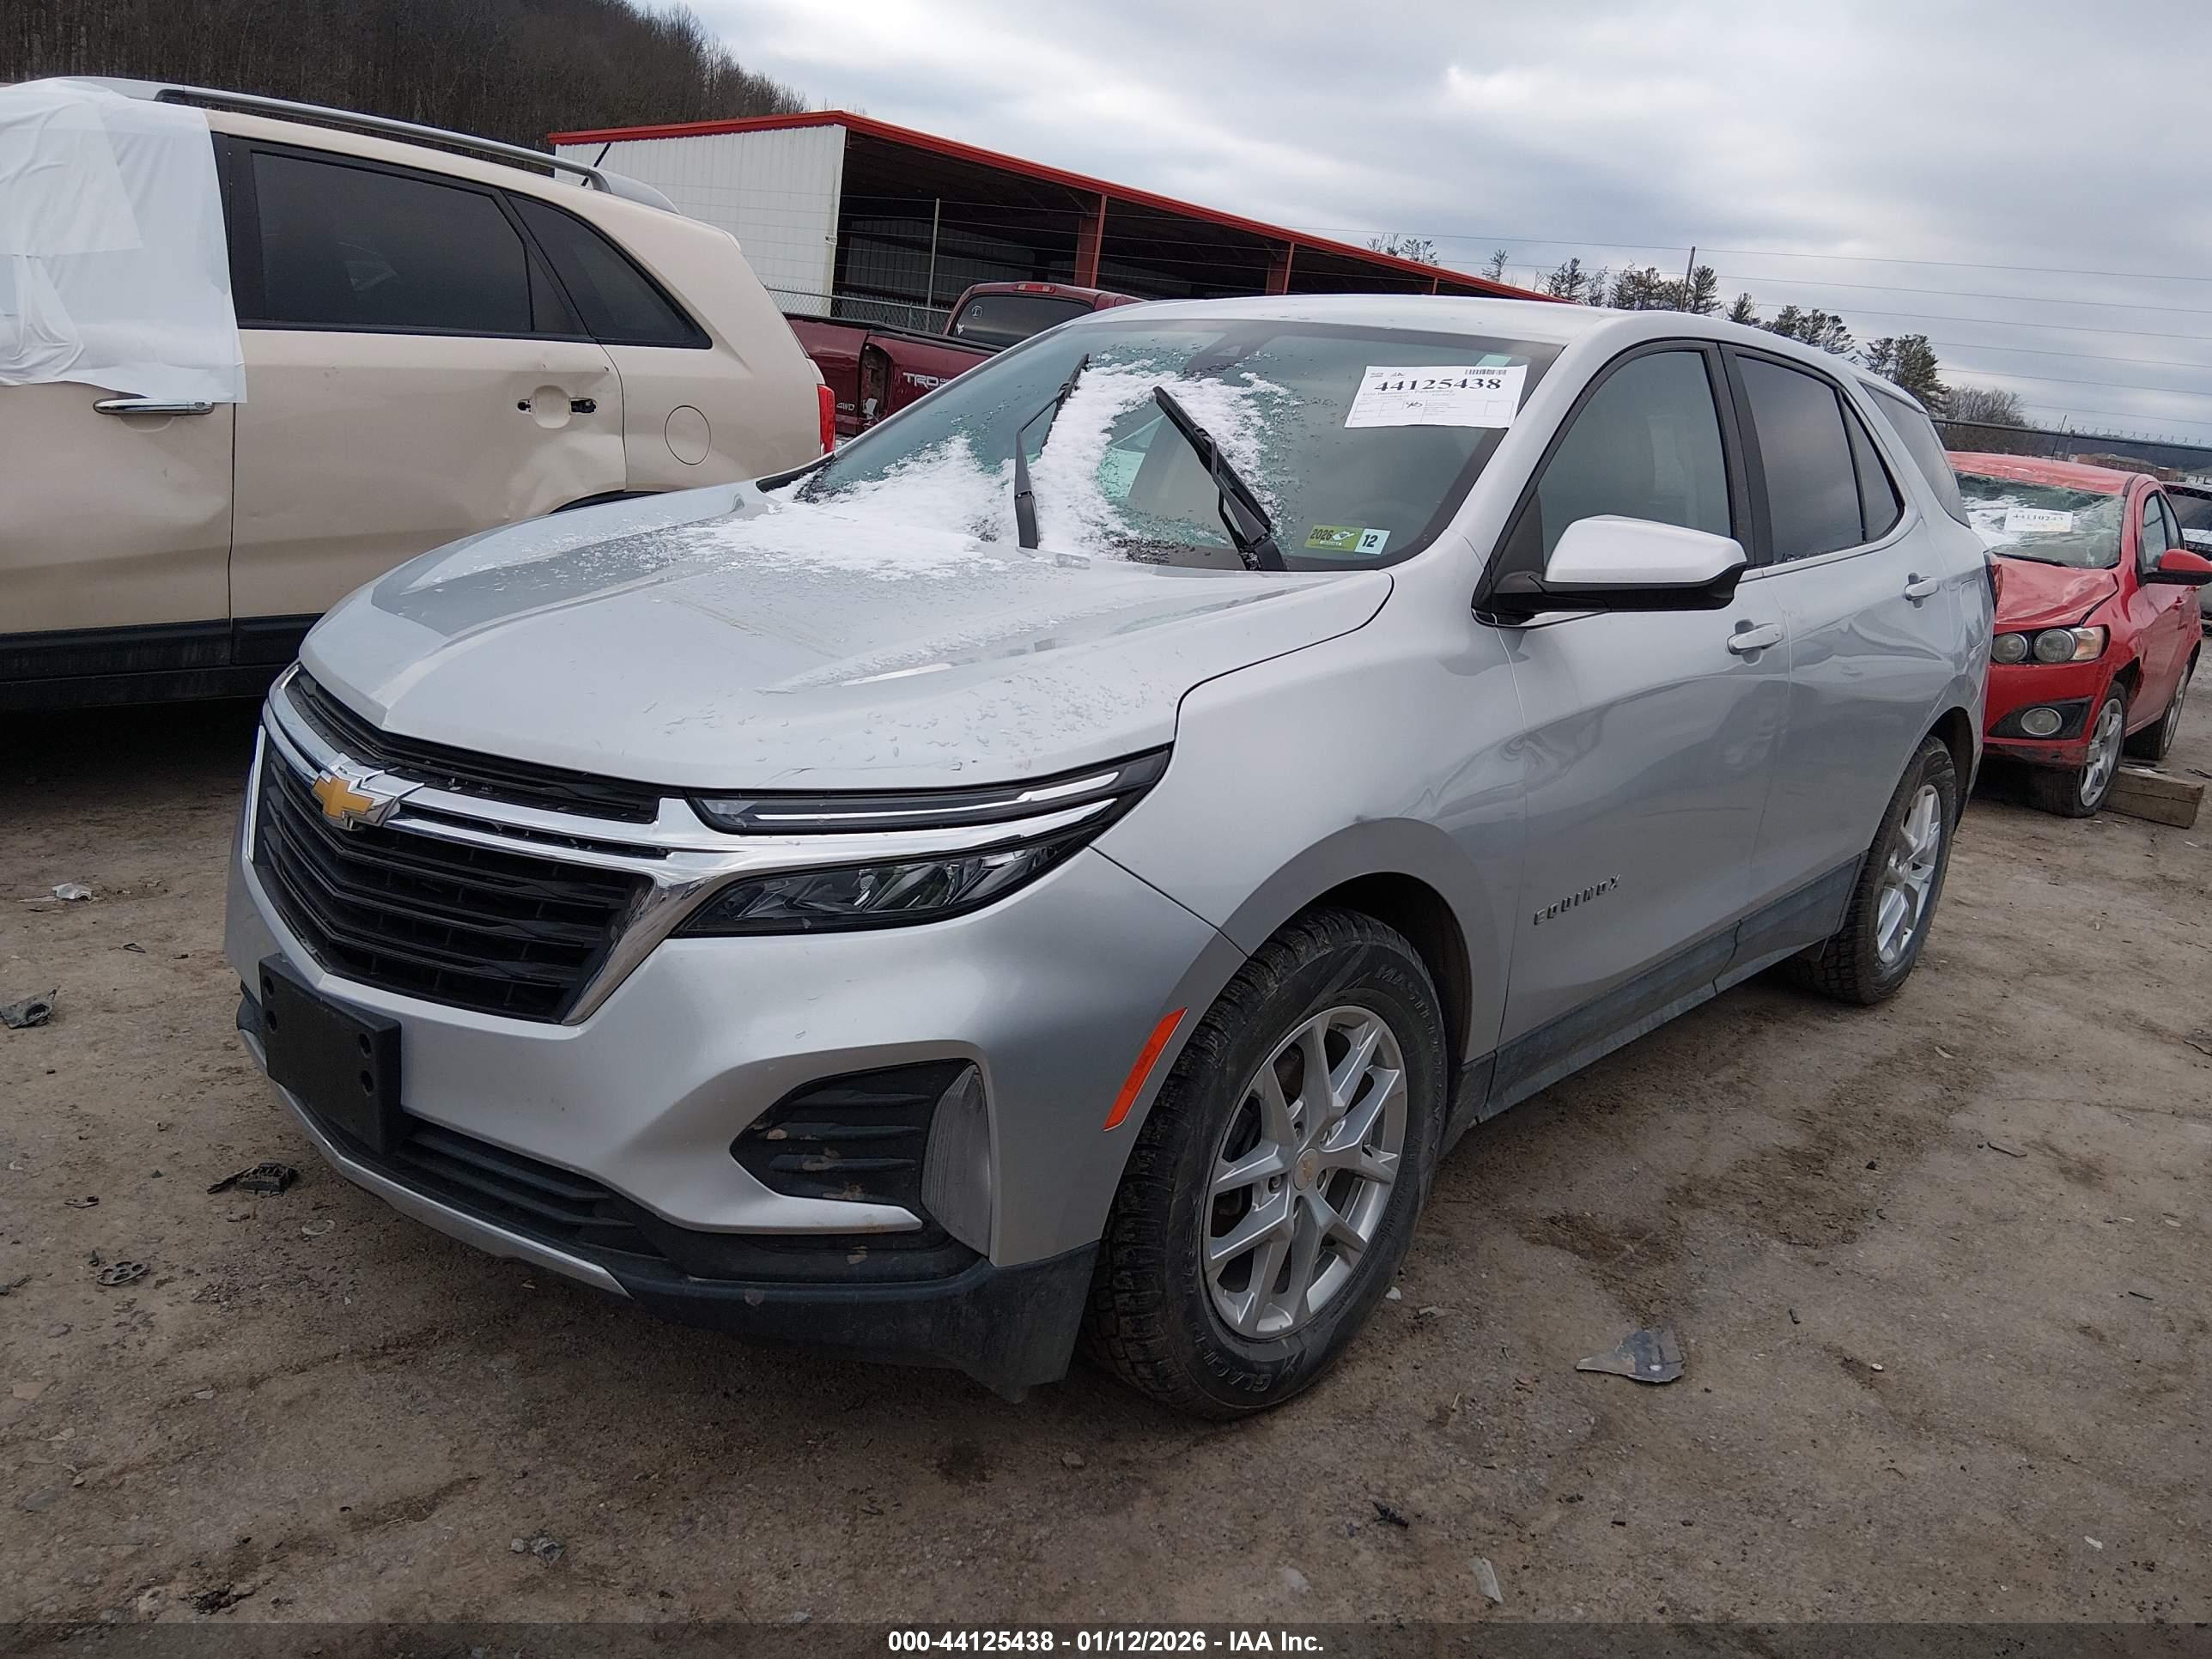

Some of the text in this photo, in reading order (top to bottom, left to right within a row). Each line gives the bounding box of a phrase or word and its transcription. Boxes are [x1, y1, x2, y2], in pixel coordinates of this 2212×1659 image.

[902, 372, 939, 389] TRD
[1375, 378, 1502, 392] 44125438
[1362, 534, 1378, 548] 12
[1534, 873, 1621, 926] EQUINOX
